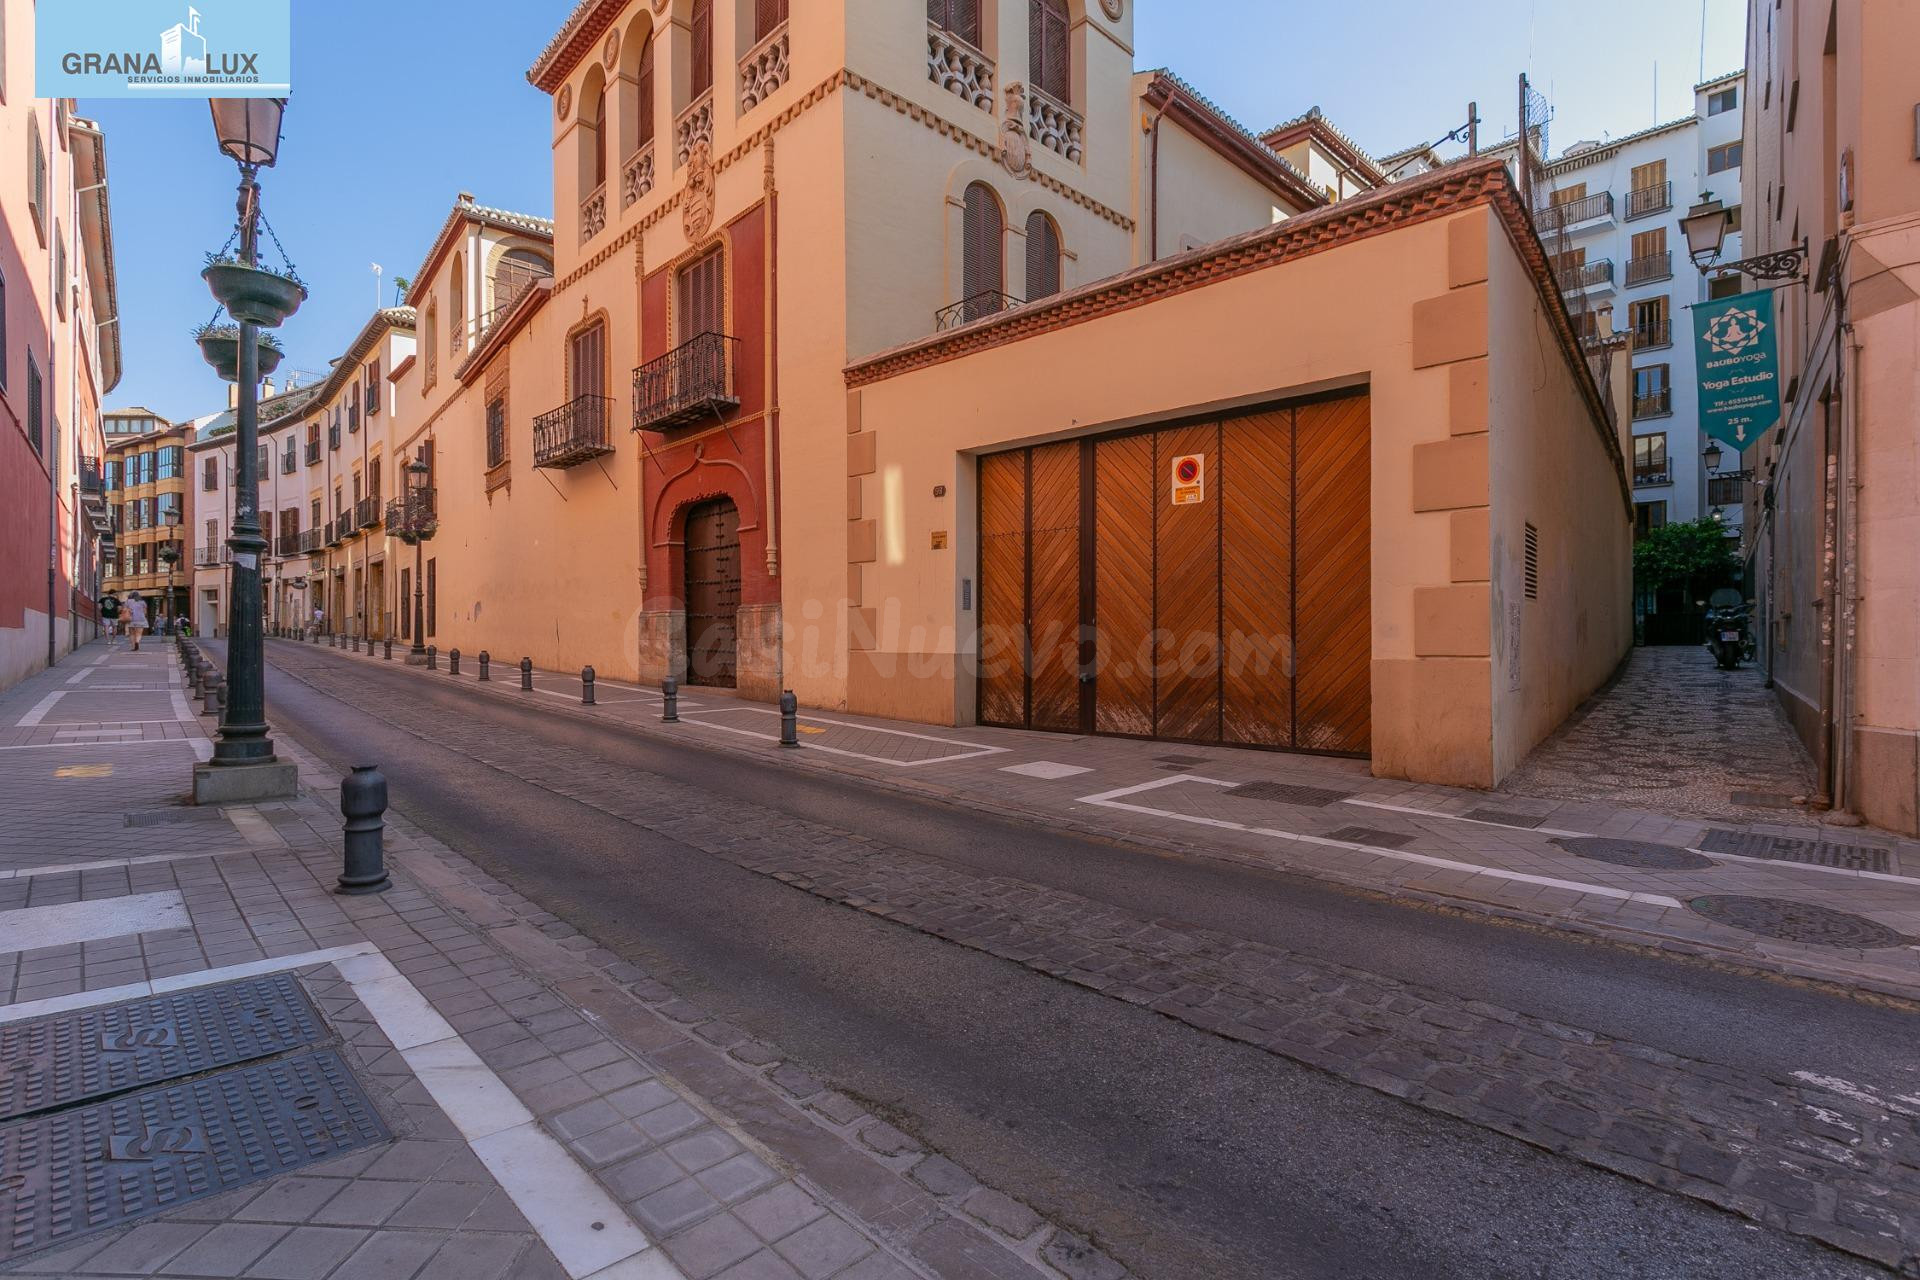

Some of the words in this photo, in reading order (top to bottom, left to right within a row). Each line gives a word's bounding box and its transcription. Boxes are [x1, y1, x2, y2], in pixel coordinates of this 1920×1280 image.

[1702, 380, 1730, 390] Yoga
[1731, 371, 1774, 386] Estudio
[1727, 417, 1739, 425] 25
